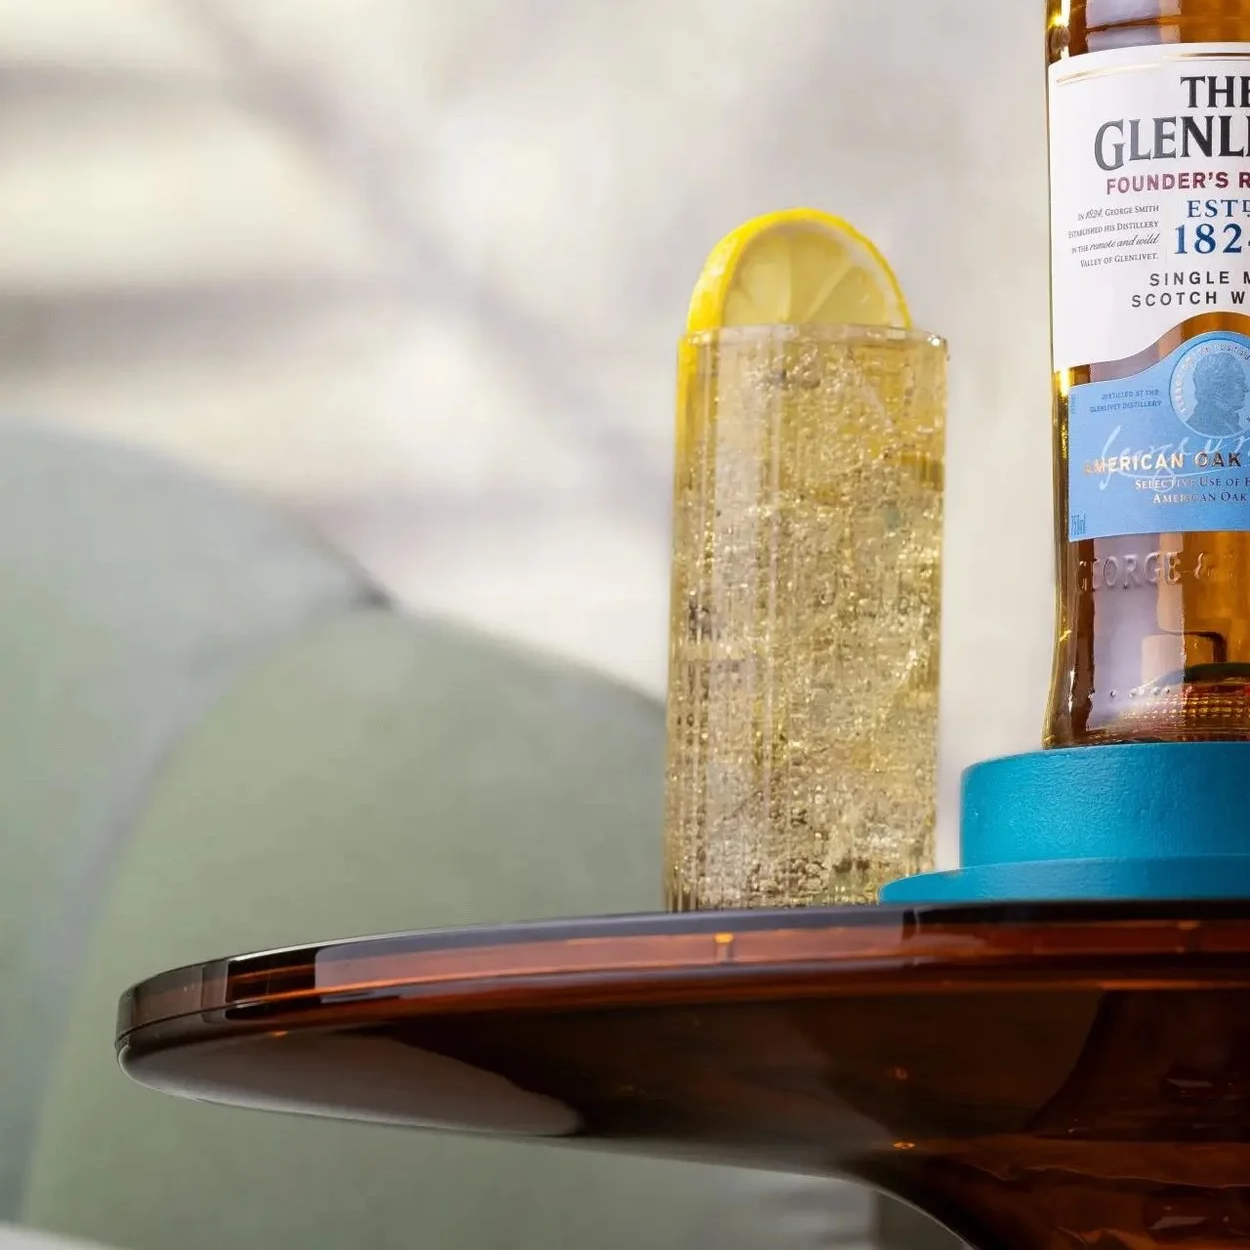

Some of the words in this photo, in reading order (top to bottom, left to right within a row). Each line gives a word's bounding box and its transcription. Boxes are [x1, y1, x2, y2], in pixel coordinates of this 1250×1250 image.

[1106, 172, 1230, 195] FOUNDER'S
[1104, 206, 1134, 217] GEORGE
[1134, 204, 1159, 214] SMITH
[1067, 226, 1103, 239] ESTABLISHED
[1116, 220, 1159, 232] DISTILLERY
[1116, 234, 1139, 247] and
[1136, 233, 1161, 245] wild
[1080, 258, 1102, 268] VALLEY
[1103, 256, 1114, 265] OF
[1149, 271, 1230, 287] SINGLE
[1131, 291, 1218, 309] SCOTCH
[1084, 453, 1184, 475] AMERICAN
[1195, 452, 1242, 468] OAK
[1135, 478, 1195, 490] SELECTIVE
[1200, 477, 1222, 487] USE
[1226, 477, 1240, 487] OF
[1152, 492, 1217, 504] AMERICAN
[1221, 491, 1249, 502] OAK
